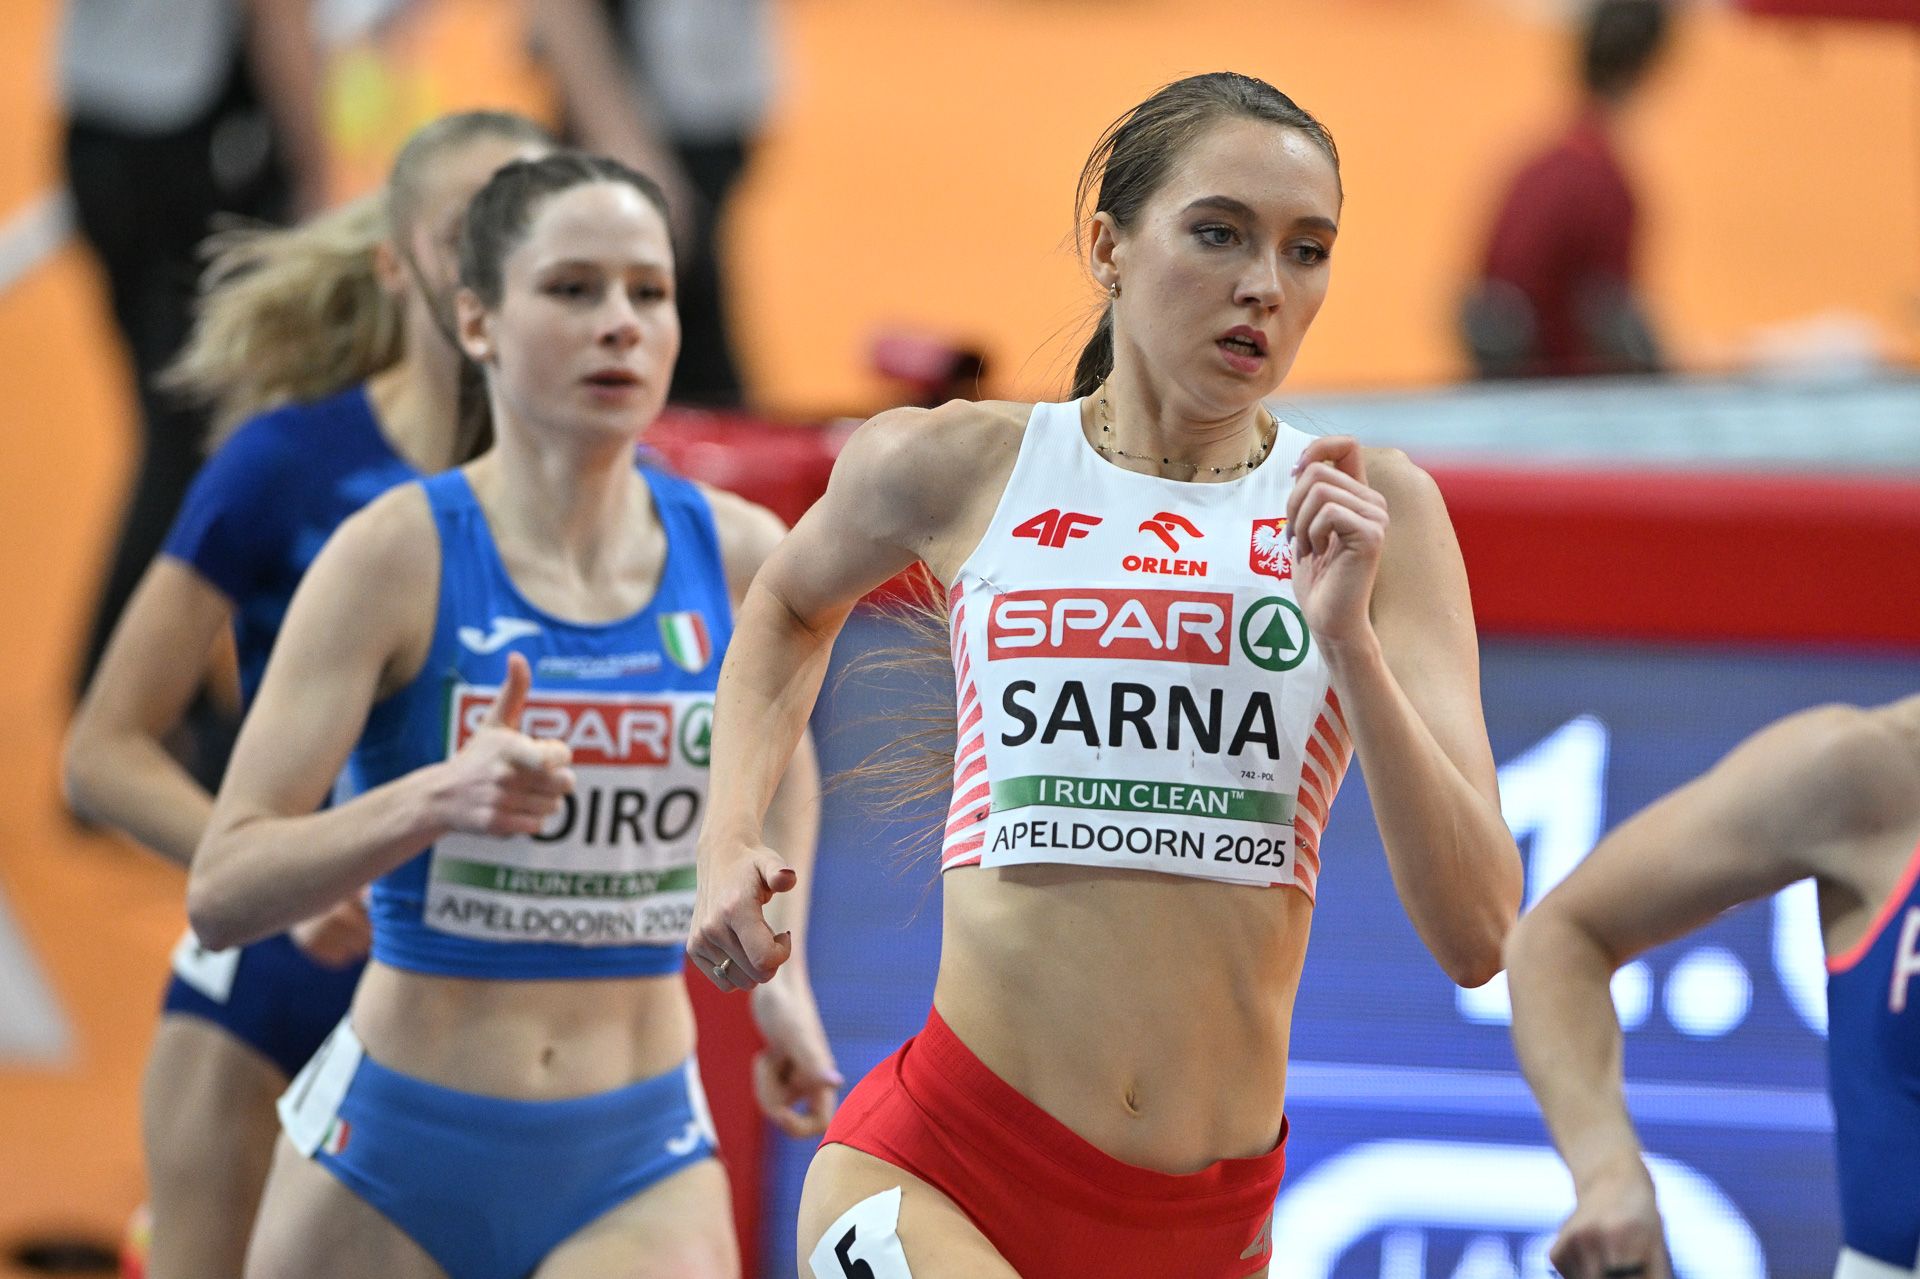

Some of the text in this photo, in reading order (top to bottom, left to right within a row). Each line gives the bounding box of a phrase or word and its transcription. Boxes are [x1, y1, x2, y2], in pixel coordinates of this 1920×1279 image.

[1122, 555, 1208, 577] ORLEN
[994, 598, 1224, 654] SPAR
[1001, 680, 1280, 760] SARNA
[1241, 770, 1256, 779] 742
[1261, 772, 1274, 781] POL
[1053, 781, 1122, 808] RUN
[992, 822, 1286, 868] APELDOORN 2025
